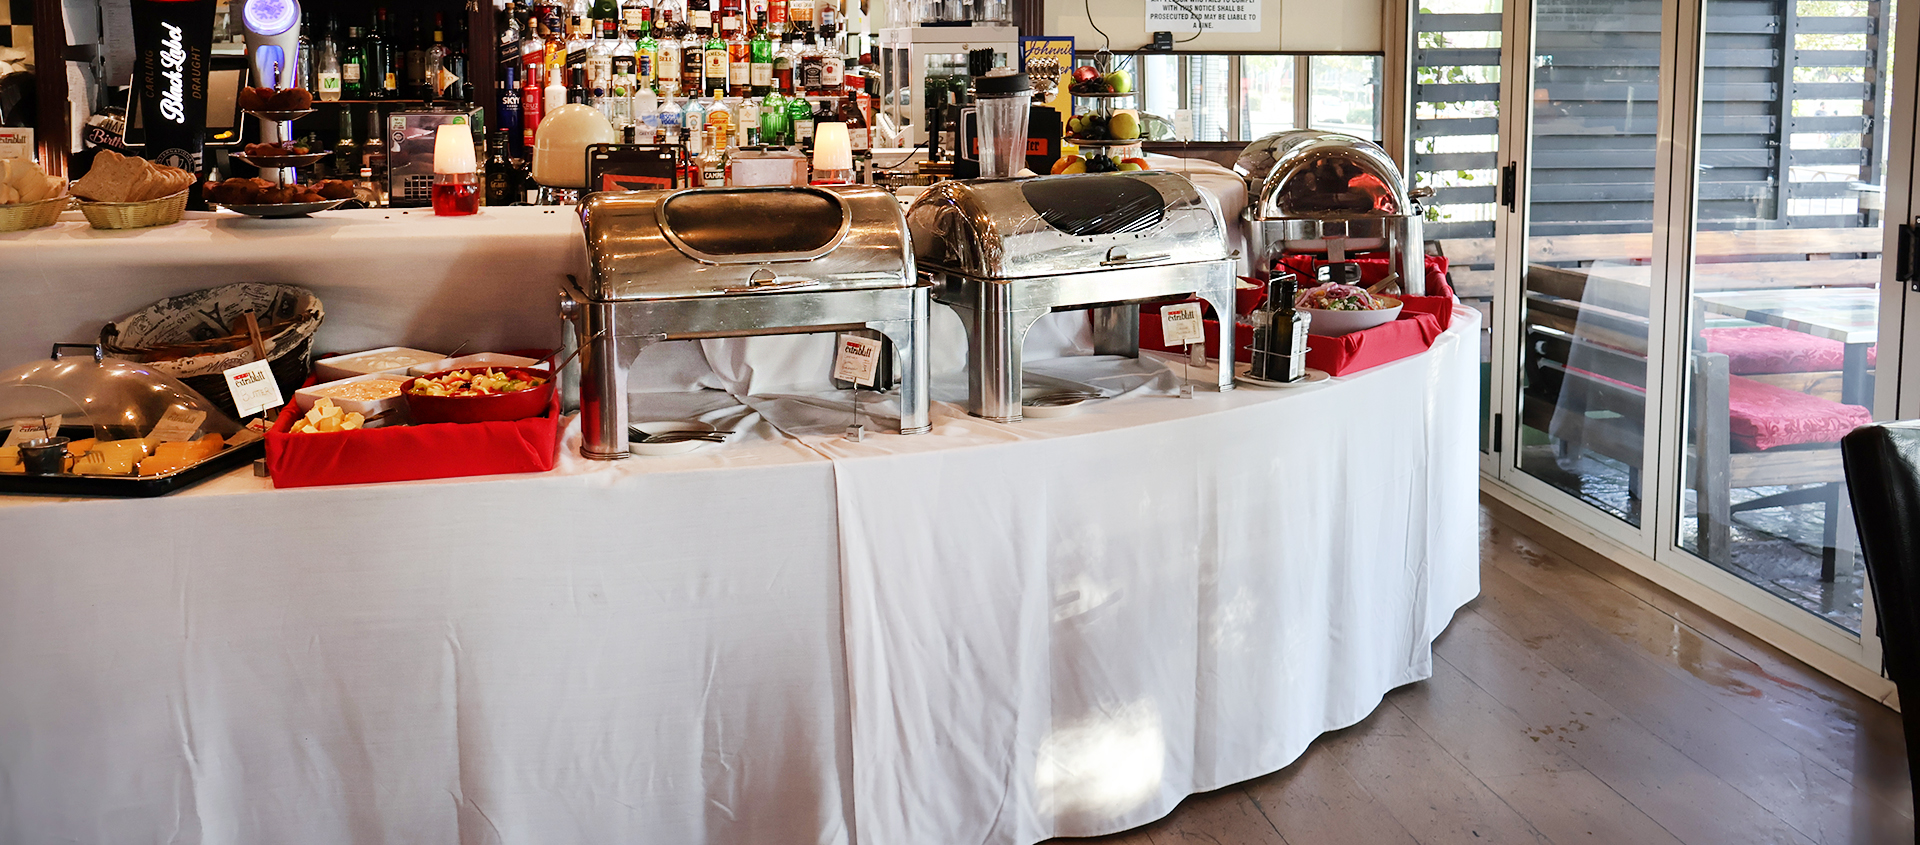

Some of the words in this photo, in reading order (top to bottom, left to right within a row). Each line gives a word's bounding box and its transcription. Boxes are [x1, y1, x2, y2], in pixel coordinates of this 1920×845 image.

[160, 21, 187, 73] Label
[191, 46, 201, 99] DRAUGHT
[145, 50, 154, 98] CARLING
[160, 71, 186, 124] Black
